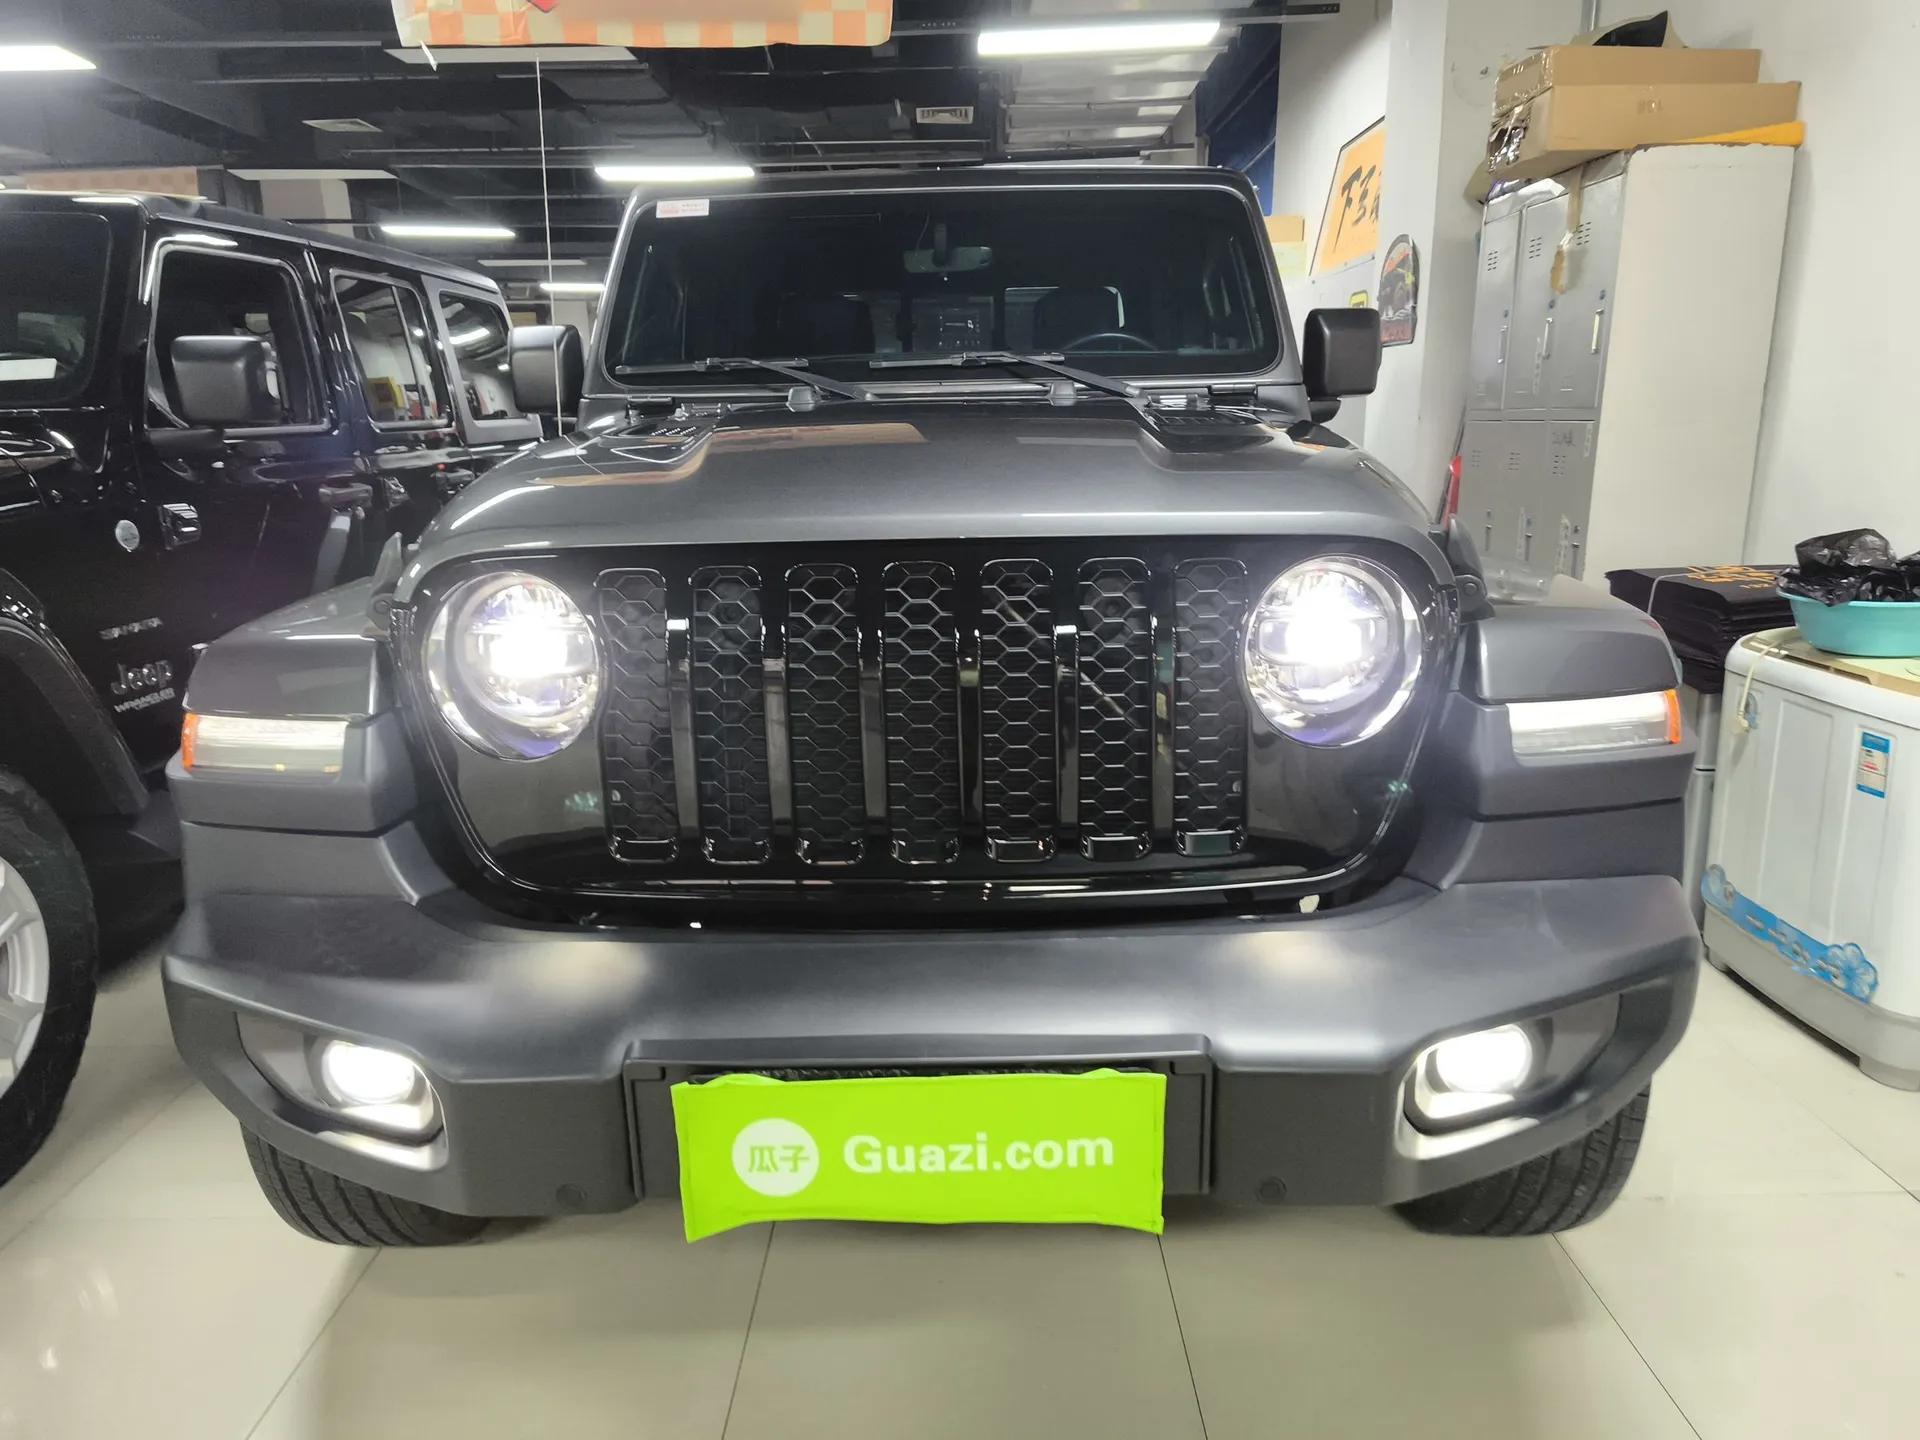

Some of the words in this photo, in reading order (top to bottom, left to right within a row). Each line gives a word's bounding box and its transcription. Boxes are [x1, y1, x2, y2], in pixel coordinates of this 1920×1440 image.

[111, 660, 173, 695] Jeep
[749, 1144, 810, 1173] 瓜子
[843, 1131, 1115, 1174] Guazi.com
